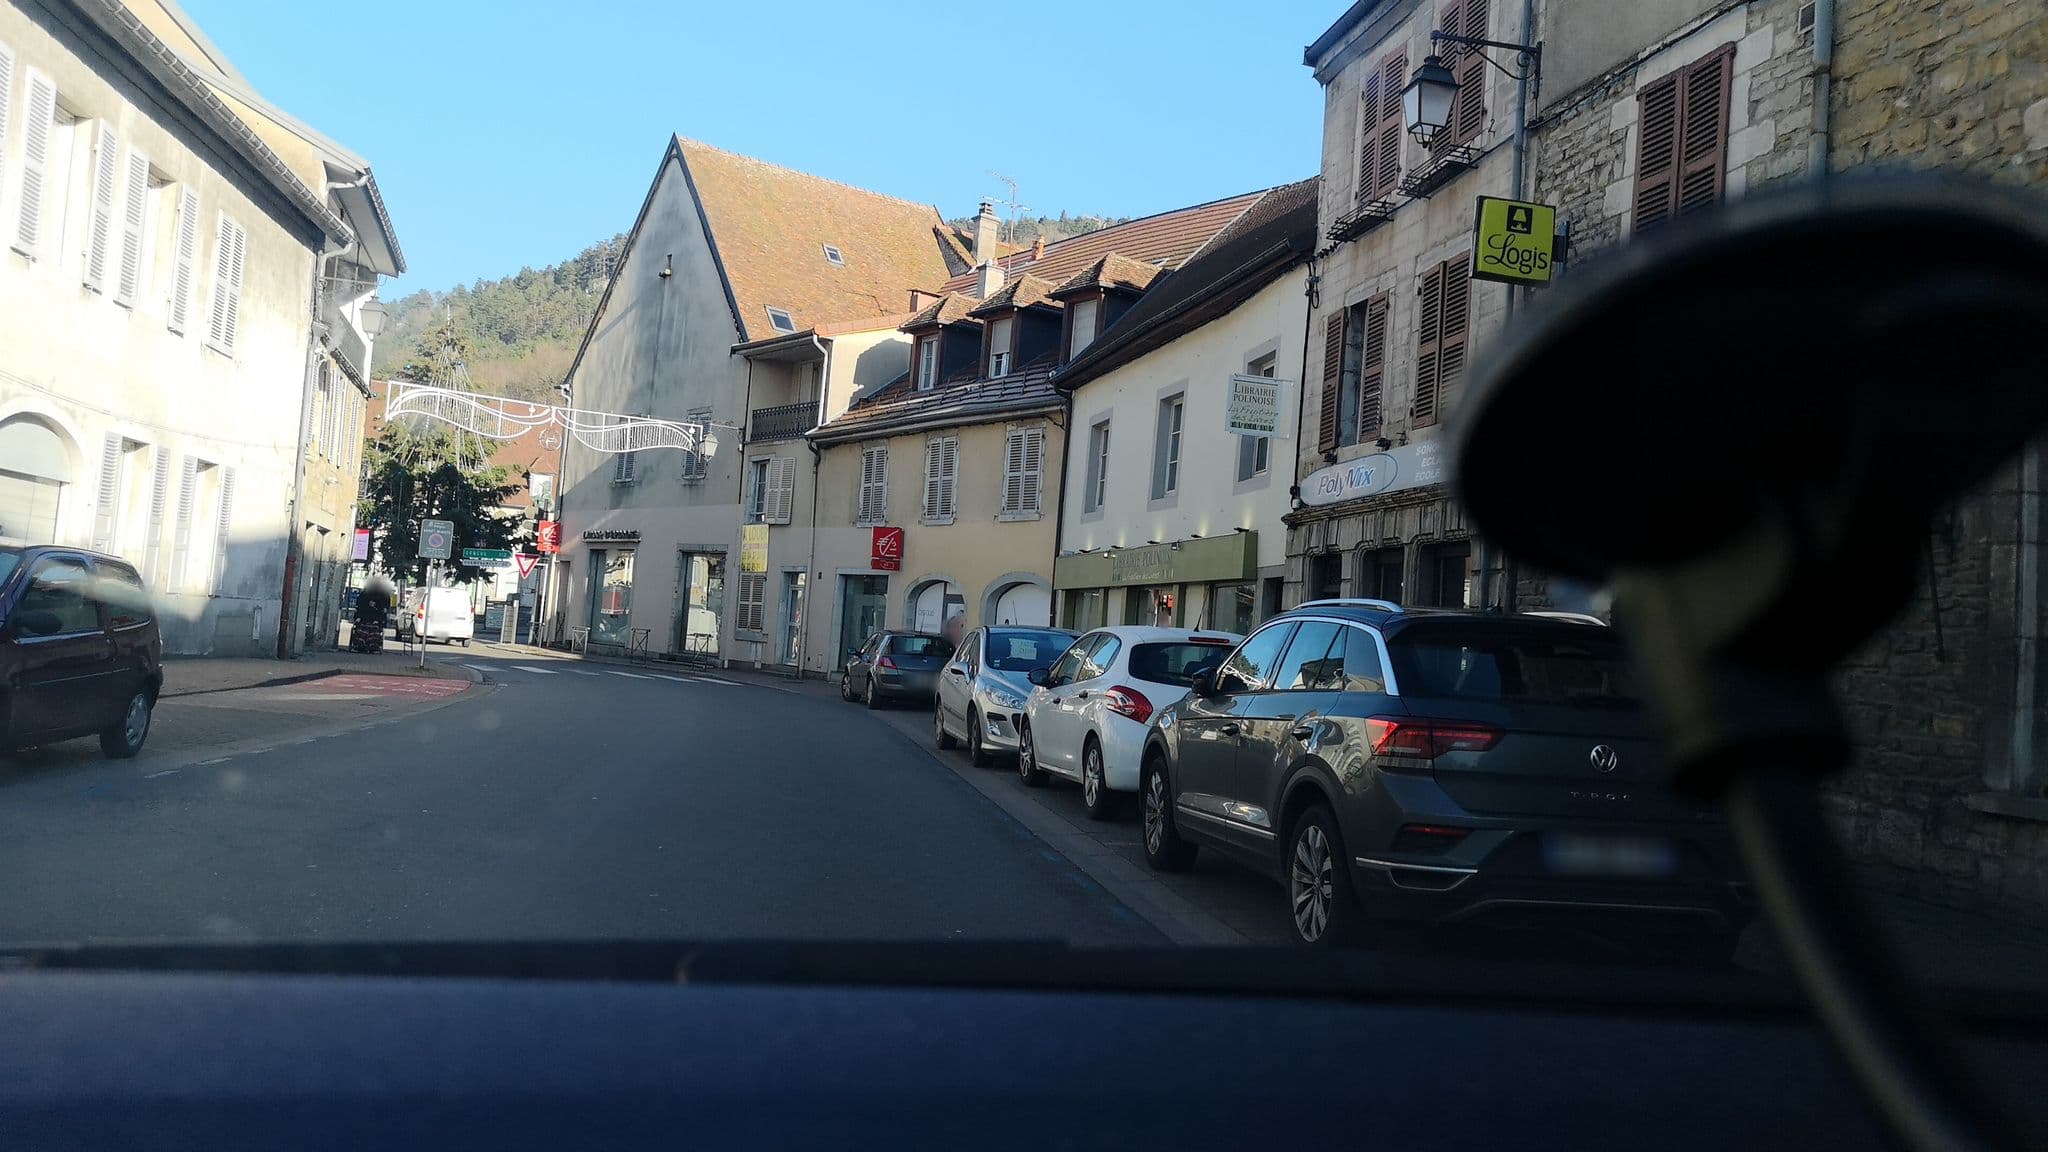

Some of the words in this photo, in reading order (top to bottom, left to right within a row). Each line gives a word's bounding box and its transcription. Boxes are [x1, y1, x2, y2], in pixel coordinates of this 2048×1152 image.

[1483, 233, 1548, 275] Logis
[1232, 394, 1276, 406] POLINOISE
[1234, 383, 1277, 398] LIBRAIRIE
[1318, 465, 1377, 498] PolyMix
